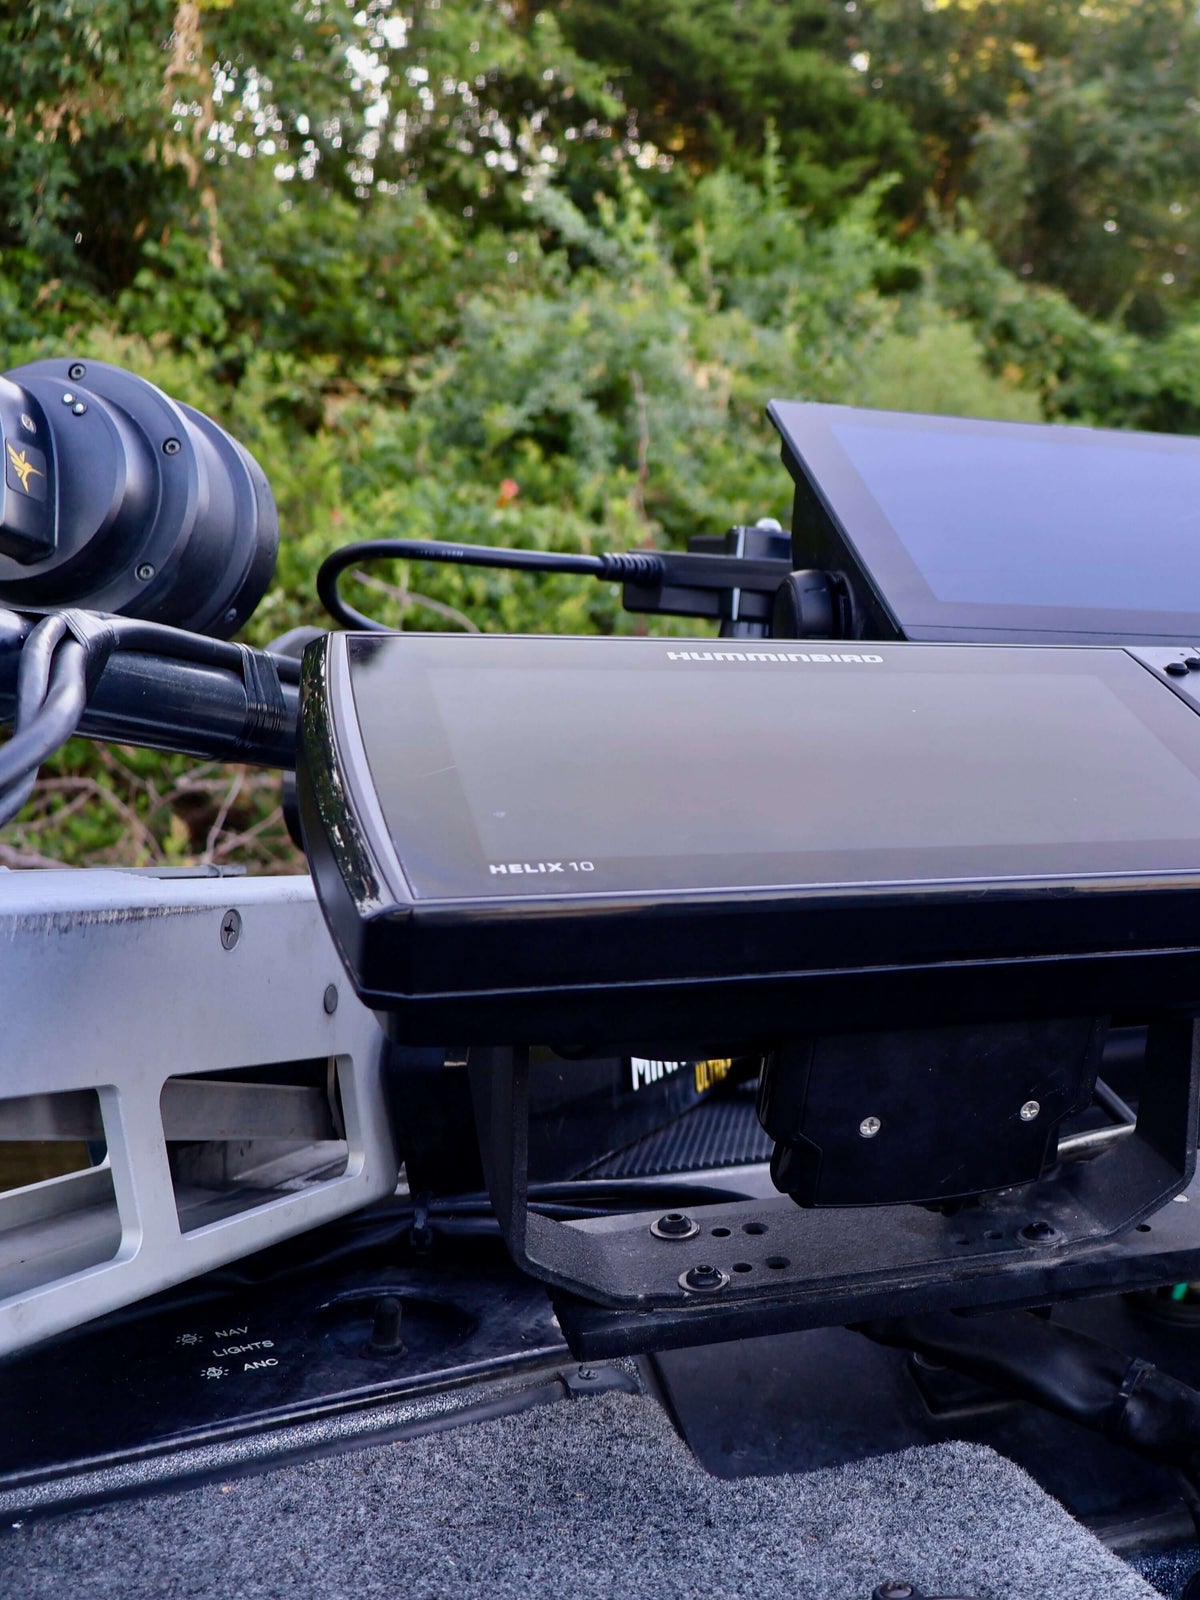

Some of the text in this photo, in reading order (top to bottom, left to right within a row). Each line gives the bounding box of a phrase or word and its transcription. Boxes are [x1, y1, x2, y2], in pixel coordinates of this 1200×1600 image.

[667, 651, 884, 664] HUMMINBIRD
[489, 861, 595, 874] HELIX 10
[214, 1326, 249, 1339] NAV
[212, 1340, 275, 1357] LIGHTS
[243, 1358, 279, 1372] ANC
